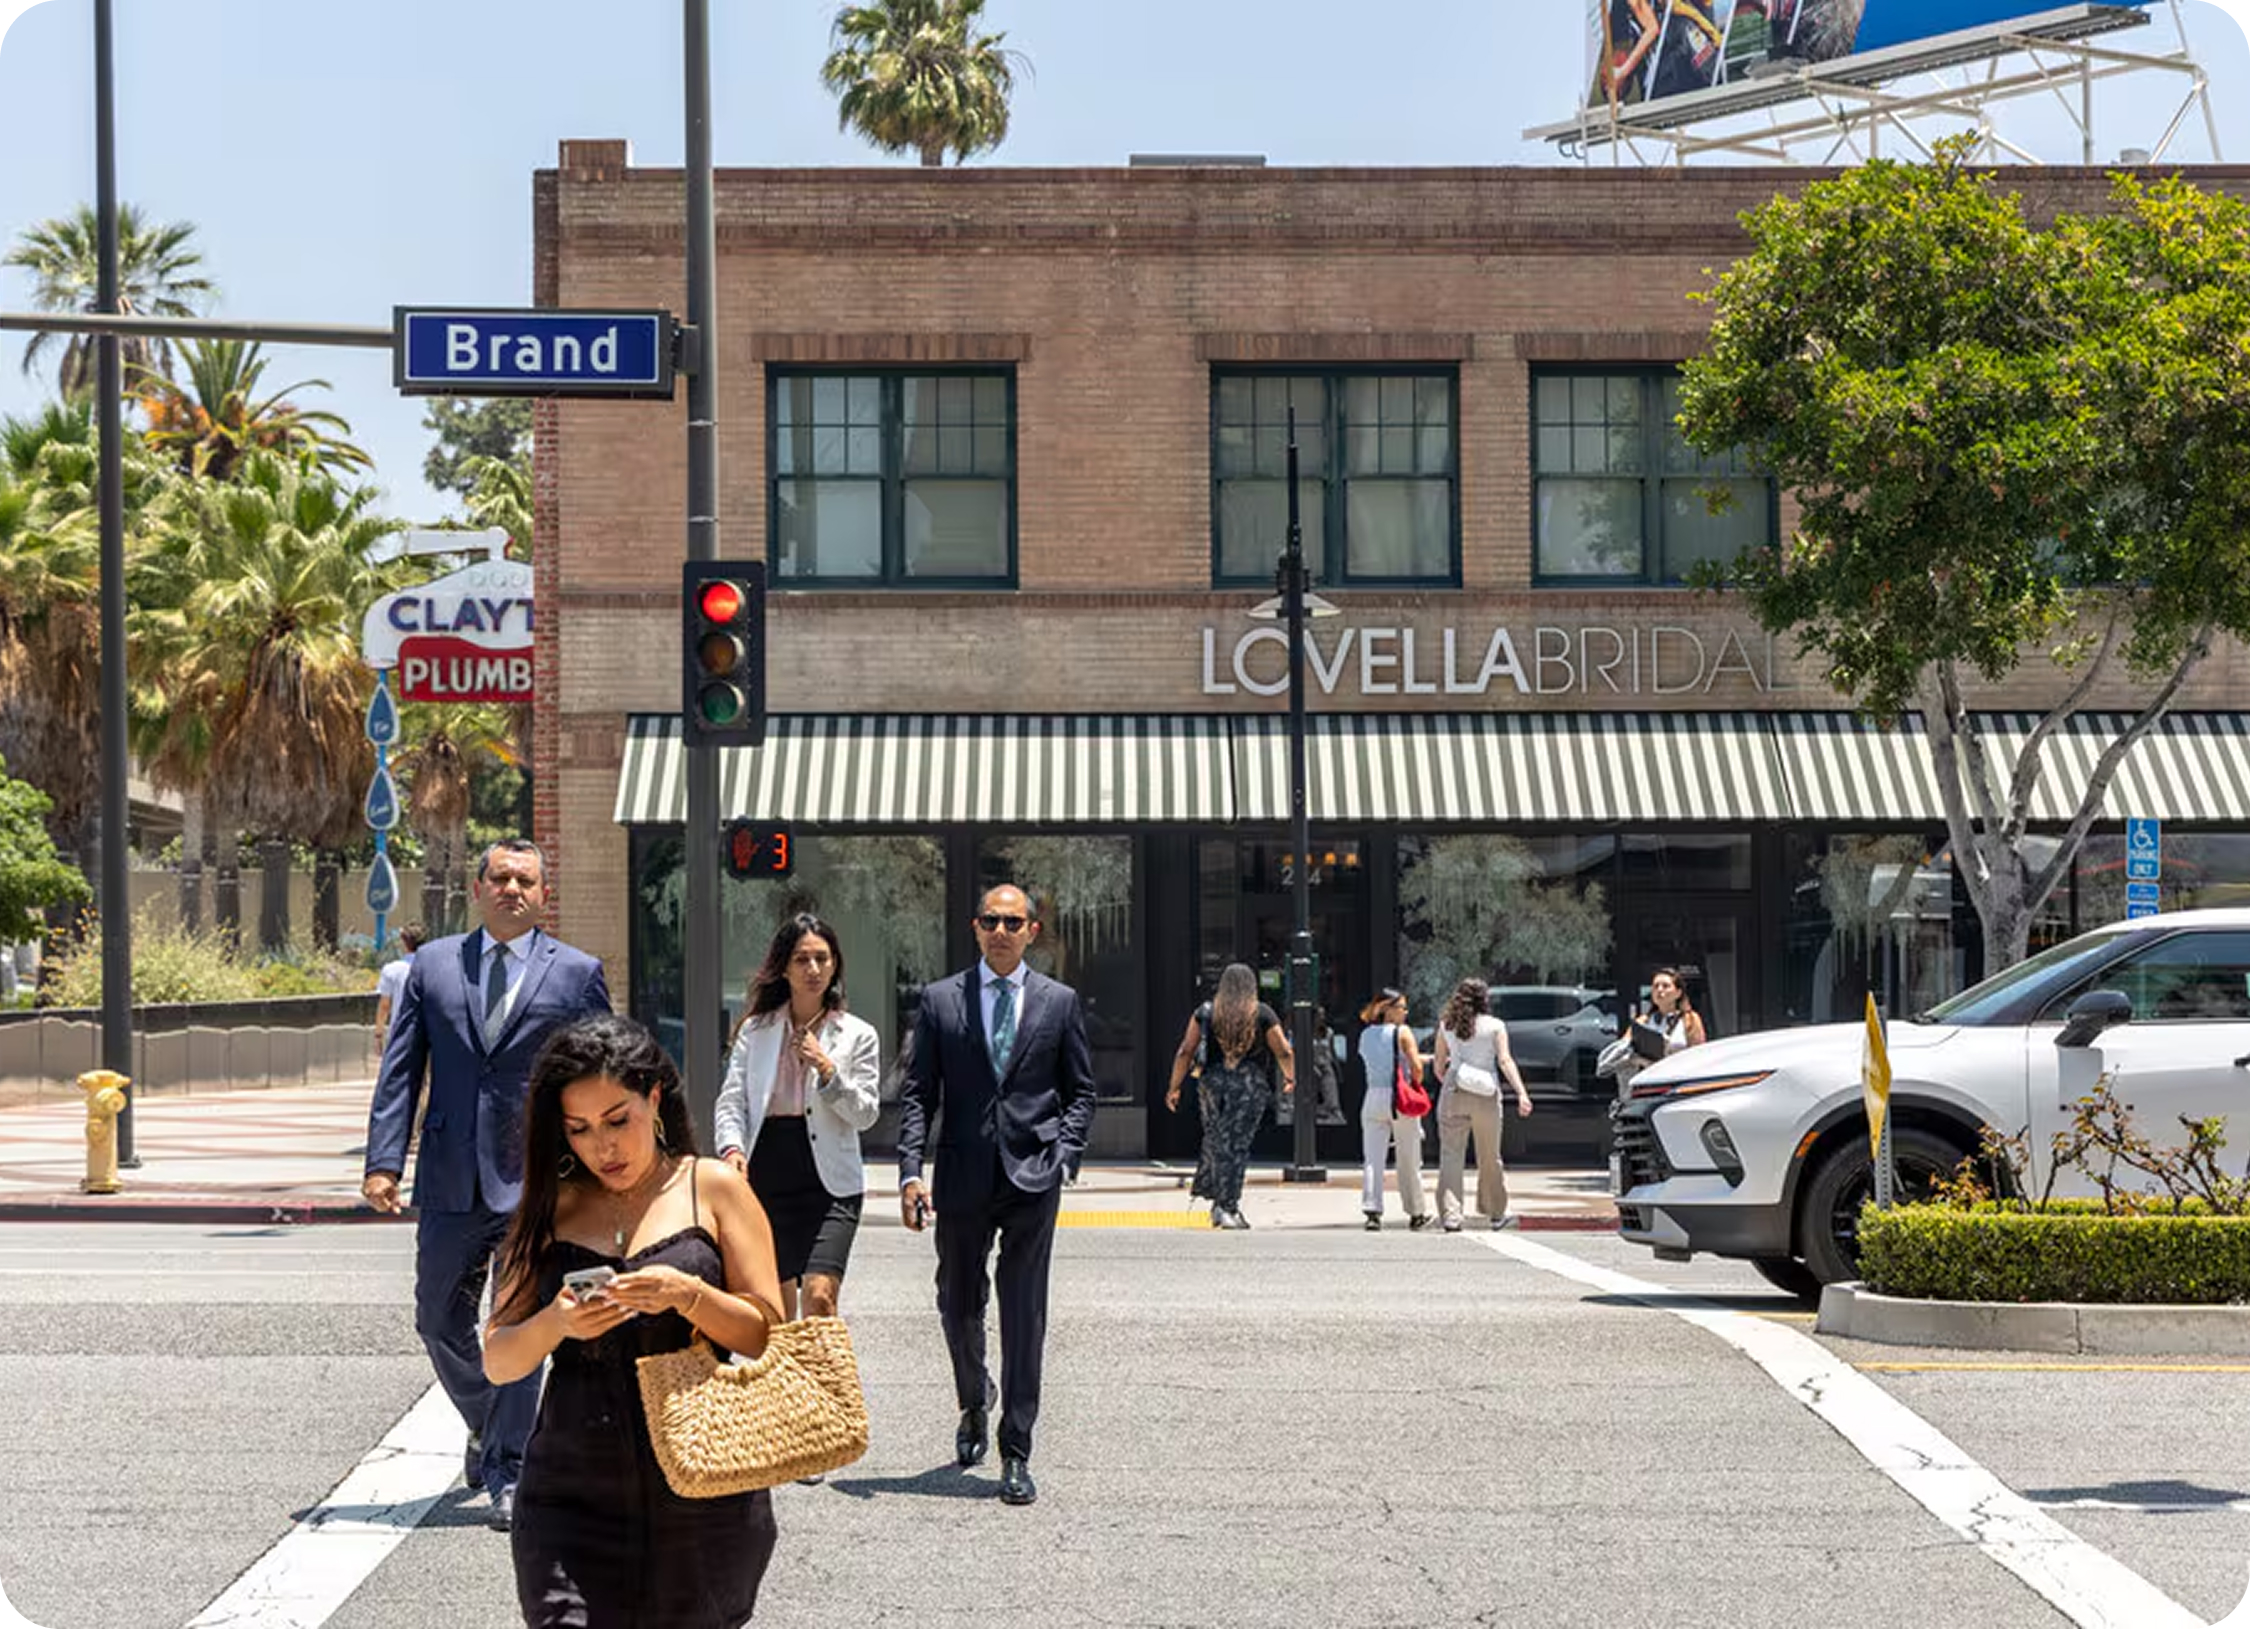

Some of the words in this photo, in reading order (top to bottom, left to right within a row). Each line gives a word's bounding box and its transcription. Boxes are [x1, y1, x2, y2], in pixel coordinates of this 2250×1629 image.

[446, 323, 617, 373] Brand
[404, 656, 533, 694] PLUMB
[1203, 625, 1531, 696] LOVELLA
[1536, 626, 1796, 694] BRIDAL
[771, 832, 789, 871] 3
[1281, 865, 1322, 886] 24
